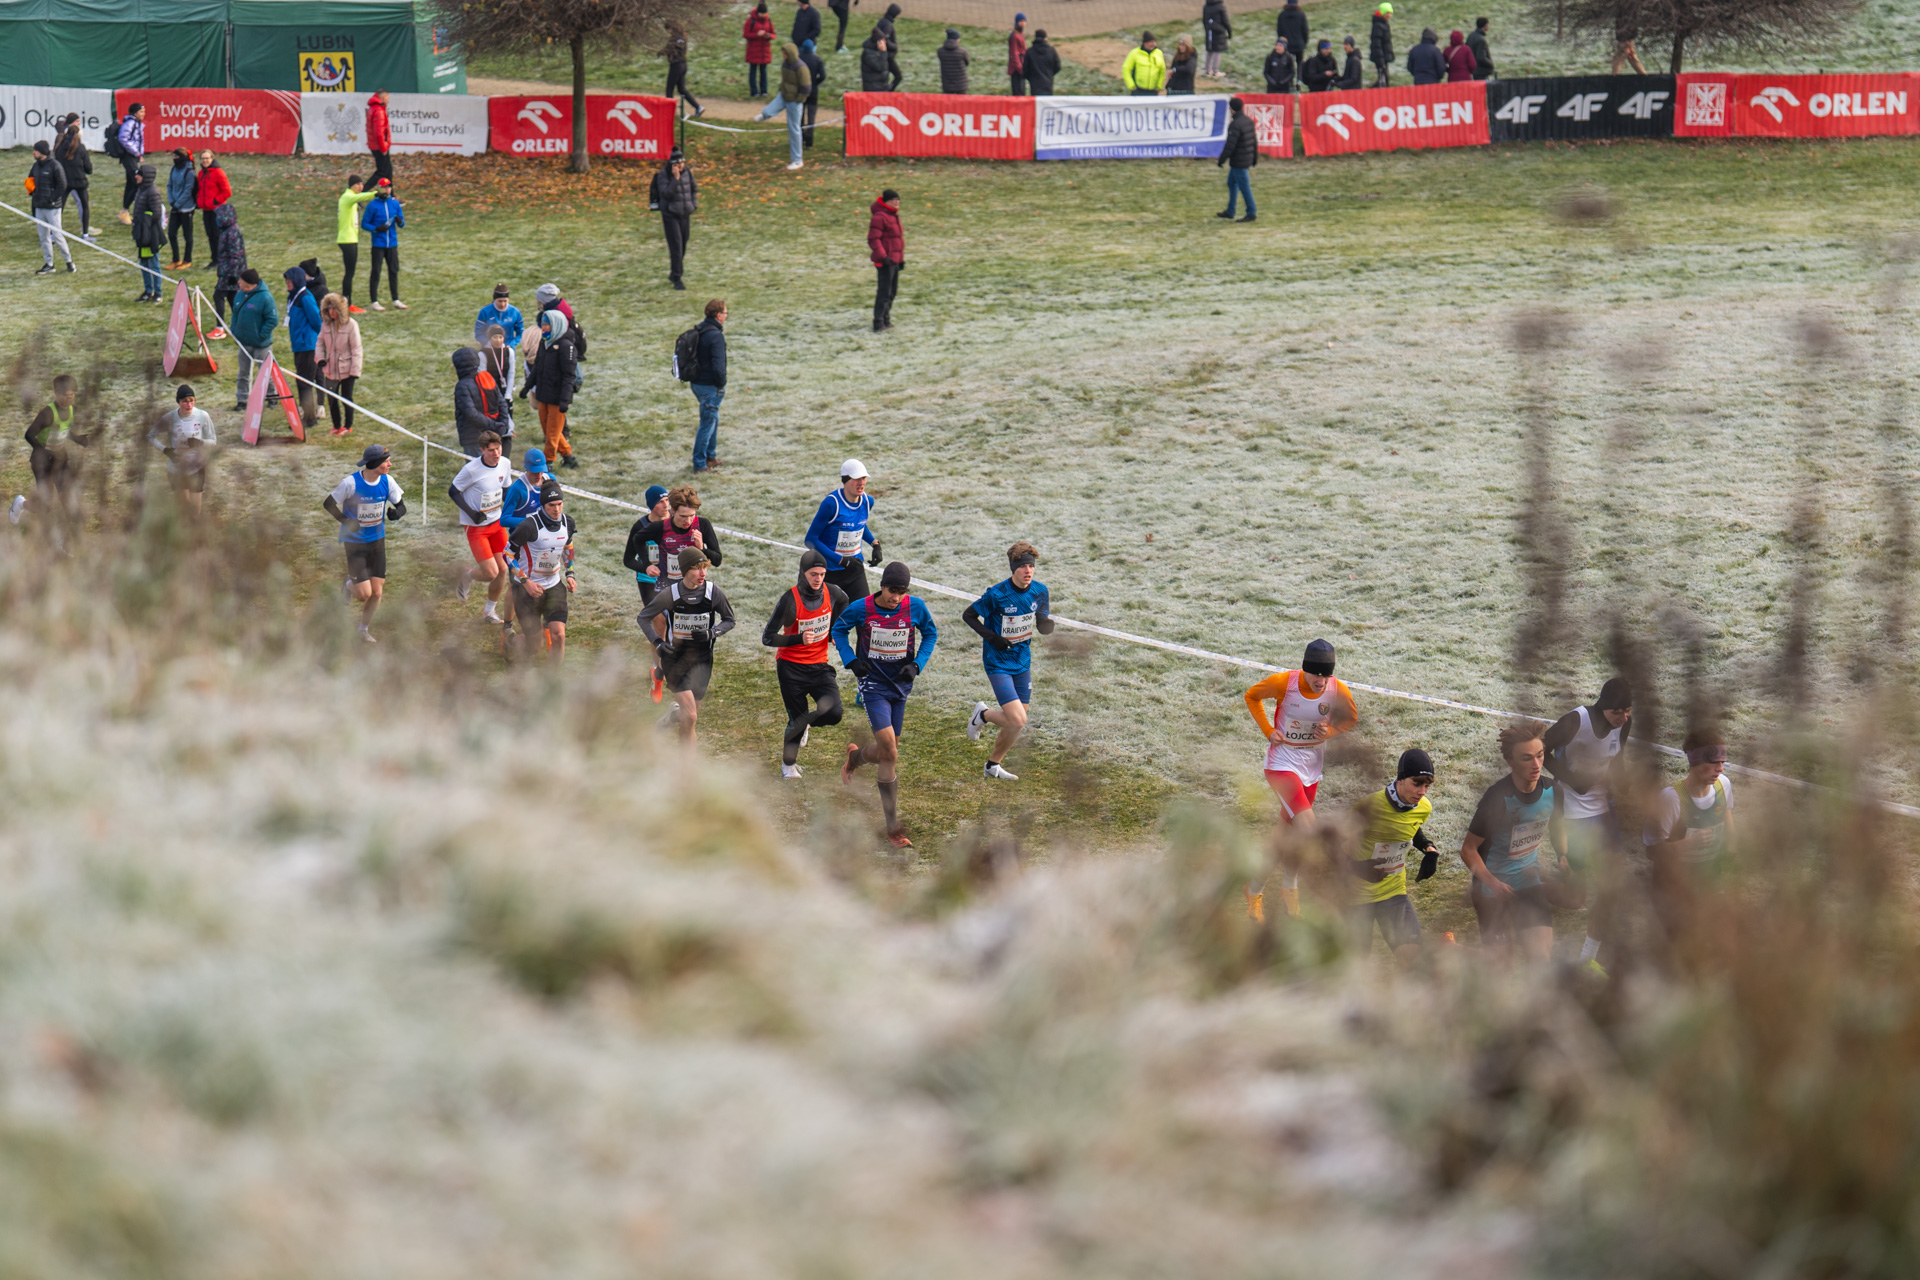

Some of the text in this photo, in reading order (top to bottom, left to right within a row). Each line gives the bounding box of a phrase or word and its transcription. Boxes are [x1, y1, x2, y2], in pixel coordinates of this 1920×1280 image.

[297, 34, 354, 49] LUBIN
[159, 101, 242, 122] tworzymy
[1495, 95, 1547, 124] 4F
[1556, 92, 1609, 121] 4F
[1617, 91, 1670, 119] 4F
[1808, 91, 1908, 118] ORLEN
[919, 112, 1021, 138] ORLEN
[1373, 101, 1473, 131] ORLEN
[160, 119, 260, 142] polski sport
[413, 122, 465, 136] Turystyki
[512, 138, 568, 153] ORLEN
[601, 138, 658, 153] ORLEN
[817, 615, 829, 623] 513
[871, 638, 906, 648] MALINOWSKI
